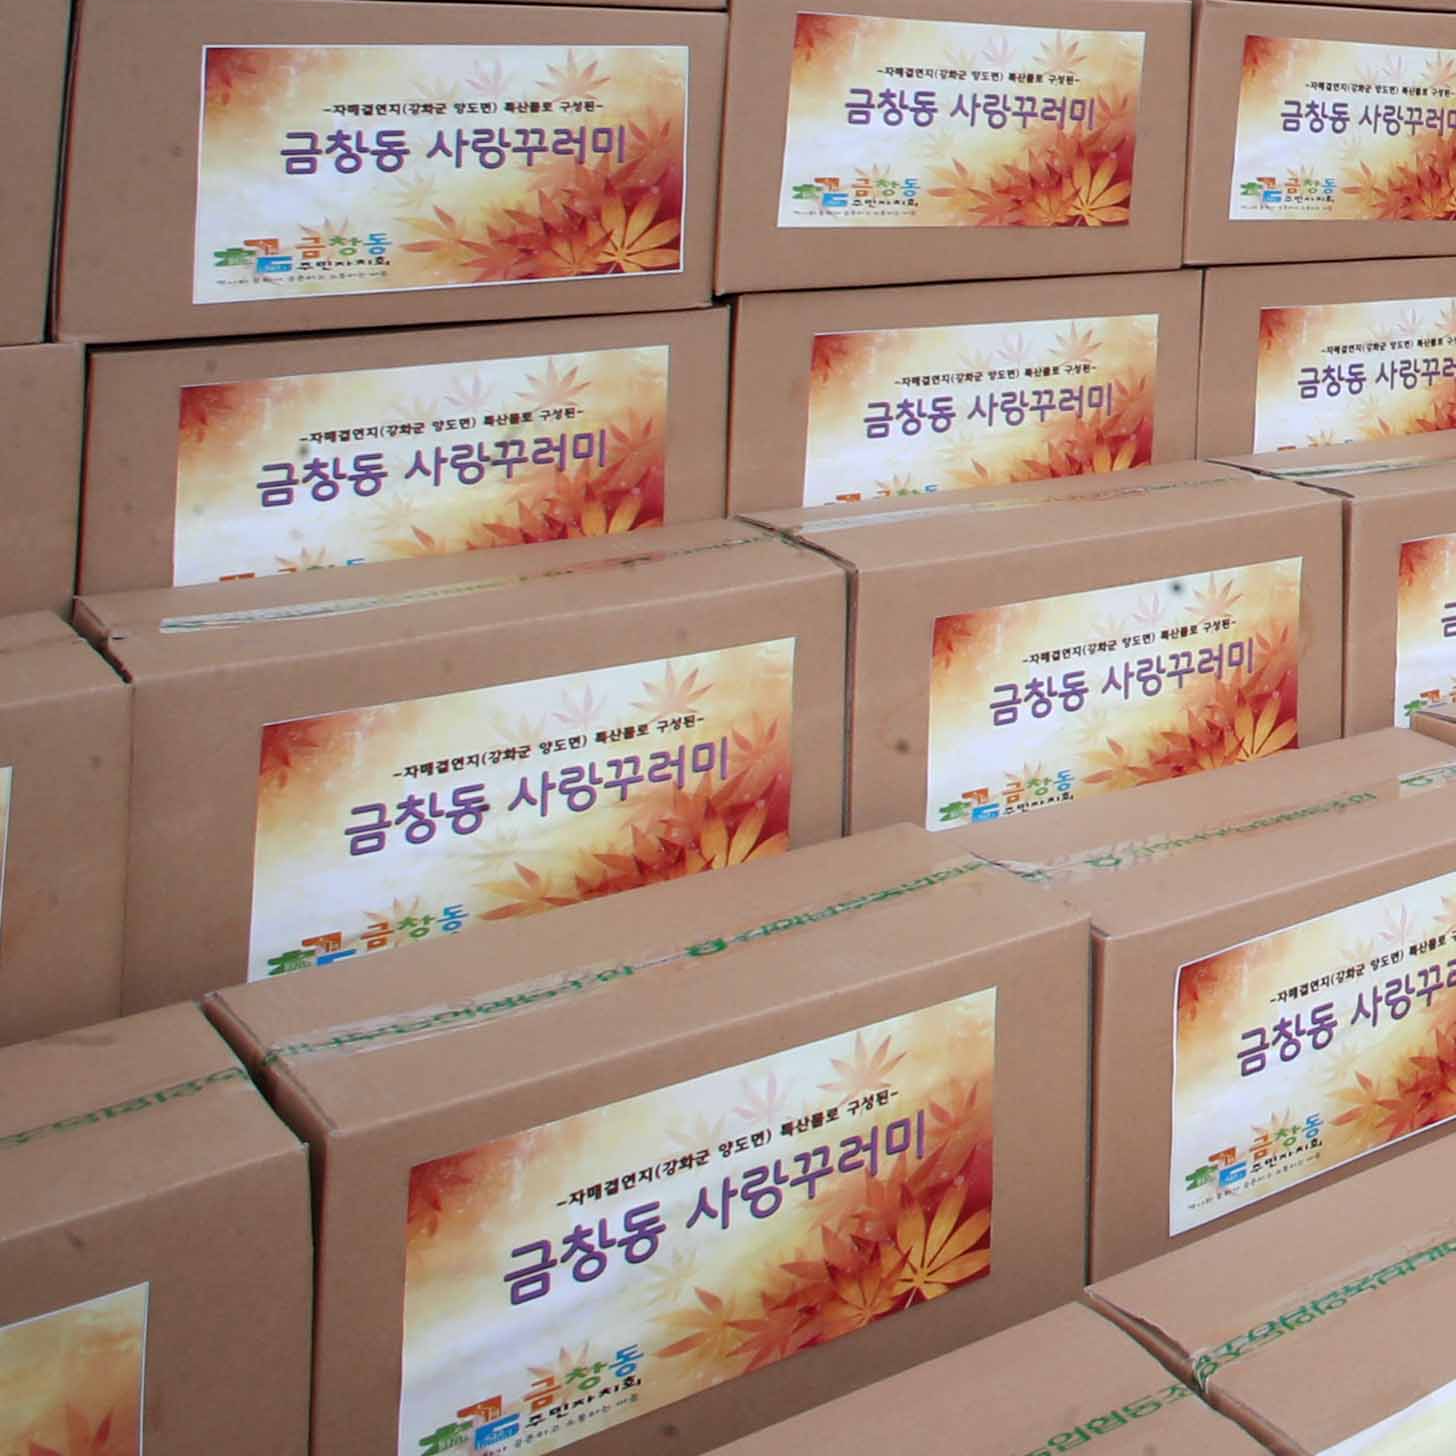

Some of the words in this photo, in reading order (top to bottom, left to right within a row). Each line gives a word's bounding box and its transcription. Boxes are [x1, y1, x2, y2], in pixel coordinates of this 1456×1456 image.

[844, 87, 940, 130] 금창동
[950, 93, 1097, 131] 사랑꾸러미
[1280, 99, 1352, 136] 금창동
[280, 128, 412, 177] 금창동
[427, 127, 627, 171] 사랑꾸러미
[863, 395, 958, 441] 금창동
[968, 385, 1114, 428] 사랑꾸러미
[1297, 362, 1369, 402] 금창동
[256, 452, 390, 510] 금창동
[406, 431, 608, 486] 사랑꾸러미
[989, 669, 1091, 729] 금창동
[1102, 640, 1256, 699] 사랑꾸러미
[344, 783, 492, 859] 금창동
[509, 739, 730, 816] 사랑꾸러미
[1236, 1001, 1339, 1080] 금창동
[558, 1149, 712, 1209] -자매결연지(강화군
[719, 1129, 773, 1160] 양도면)
[848, 1090, 900, 1116] 구성된-
[504, 1201, 668, 1308] 금창동
[687, 1113, 927, 1227] 사랑꾸러미
[523, 1342, 645, 1415] 금창동
